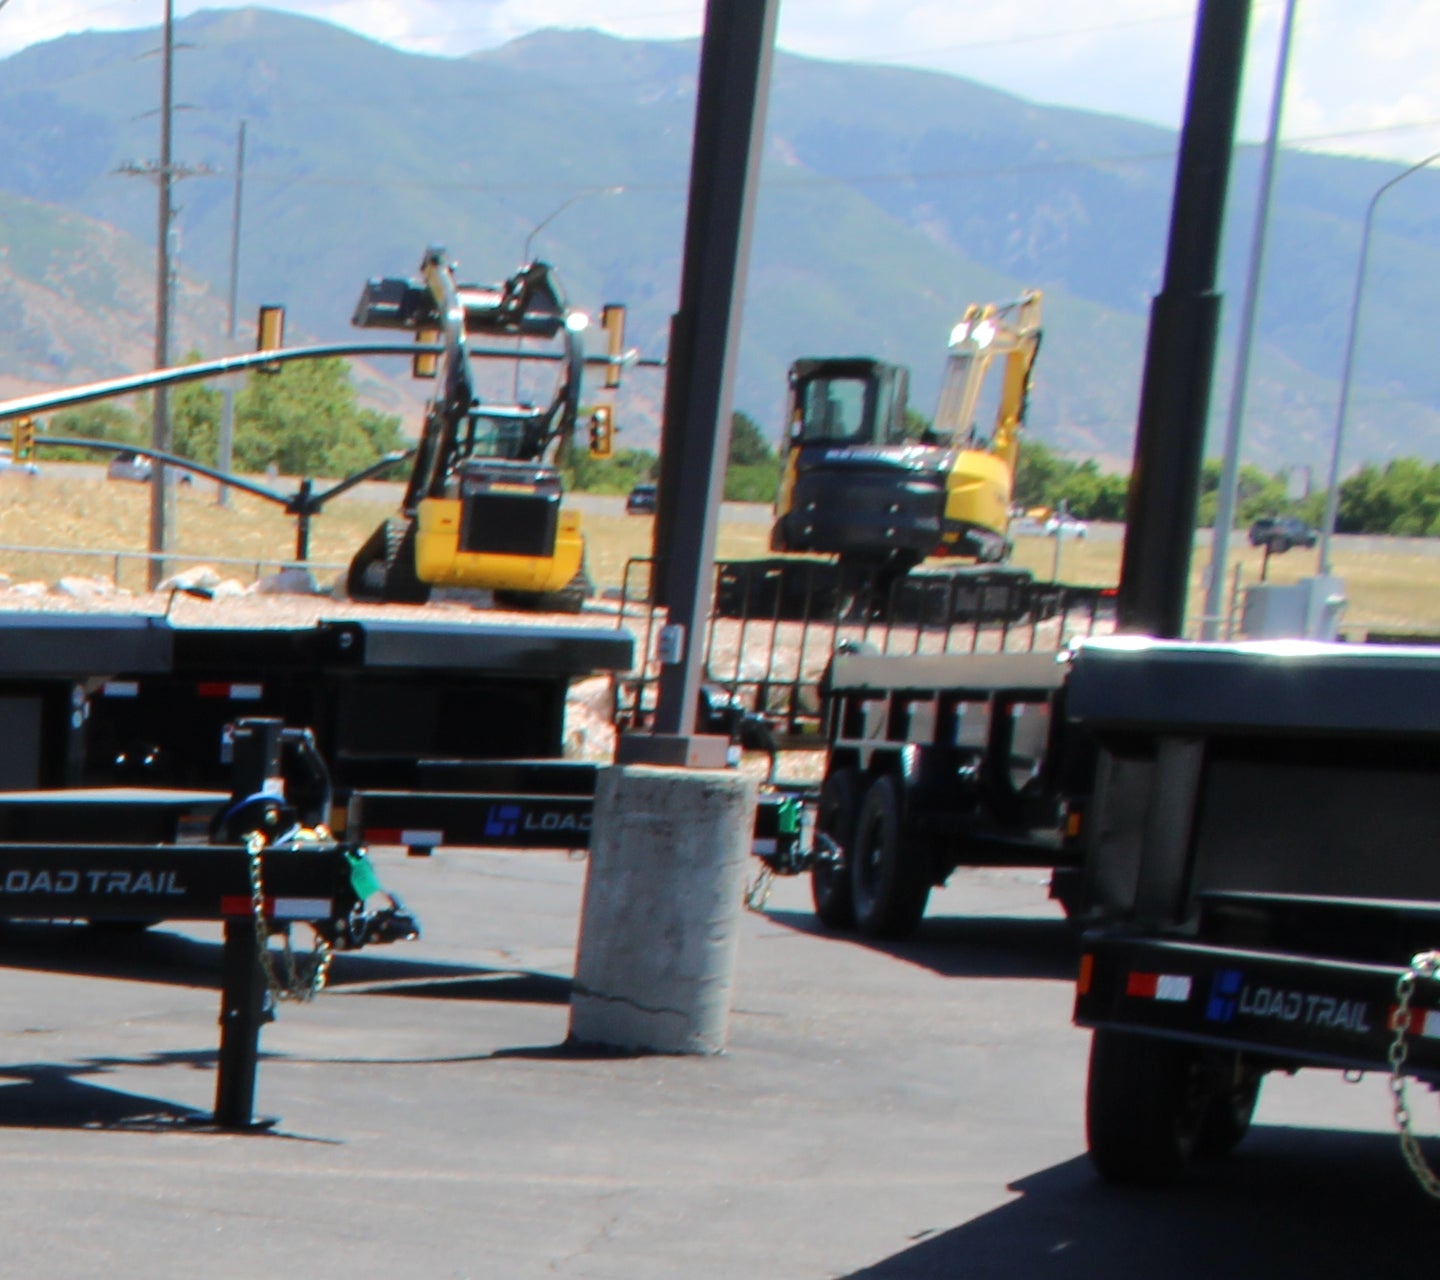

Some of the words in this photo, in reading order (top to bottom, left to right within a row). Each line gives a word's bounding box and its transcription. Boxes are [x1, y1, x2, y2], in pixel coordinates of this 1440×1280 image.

[85, 869, 188, 895] TRAIL
[1238, 984, 1302, 1021] LOAD
[1304, 994, 1372, 1033] TRAIL
